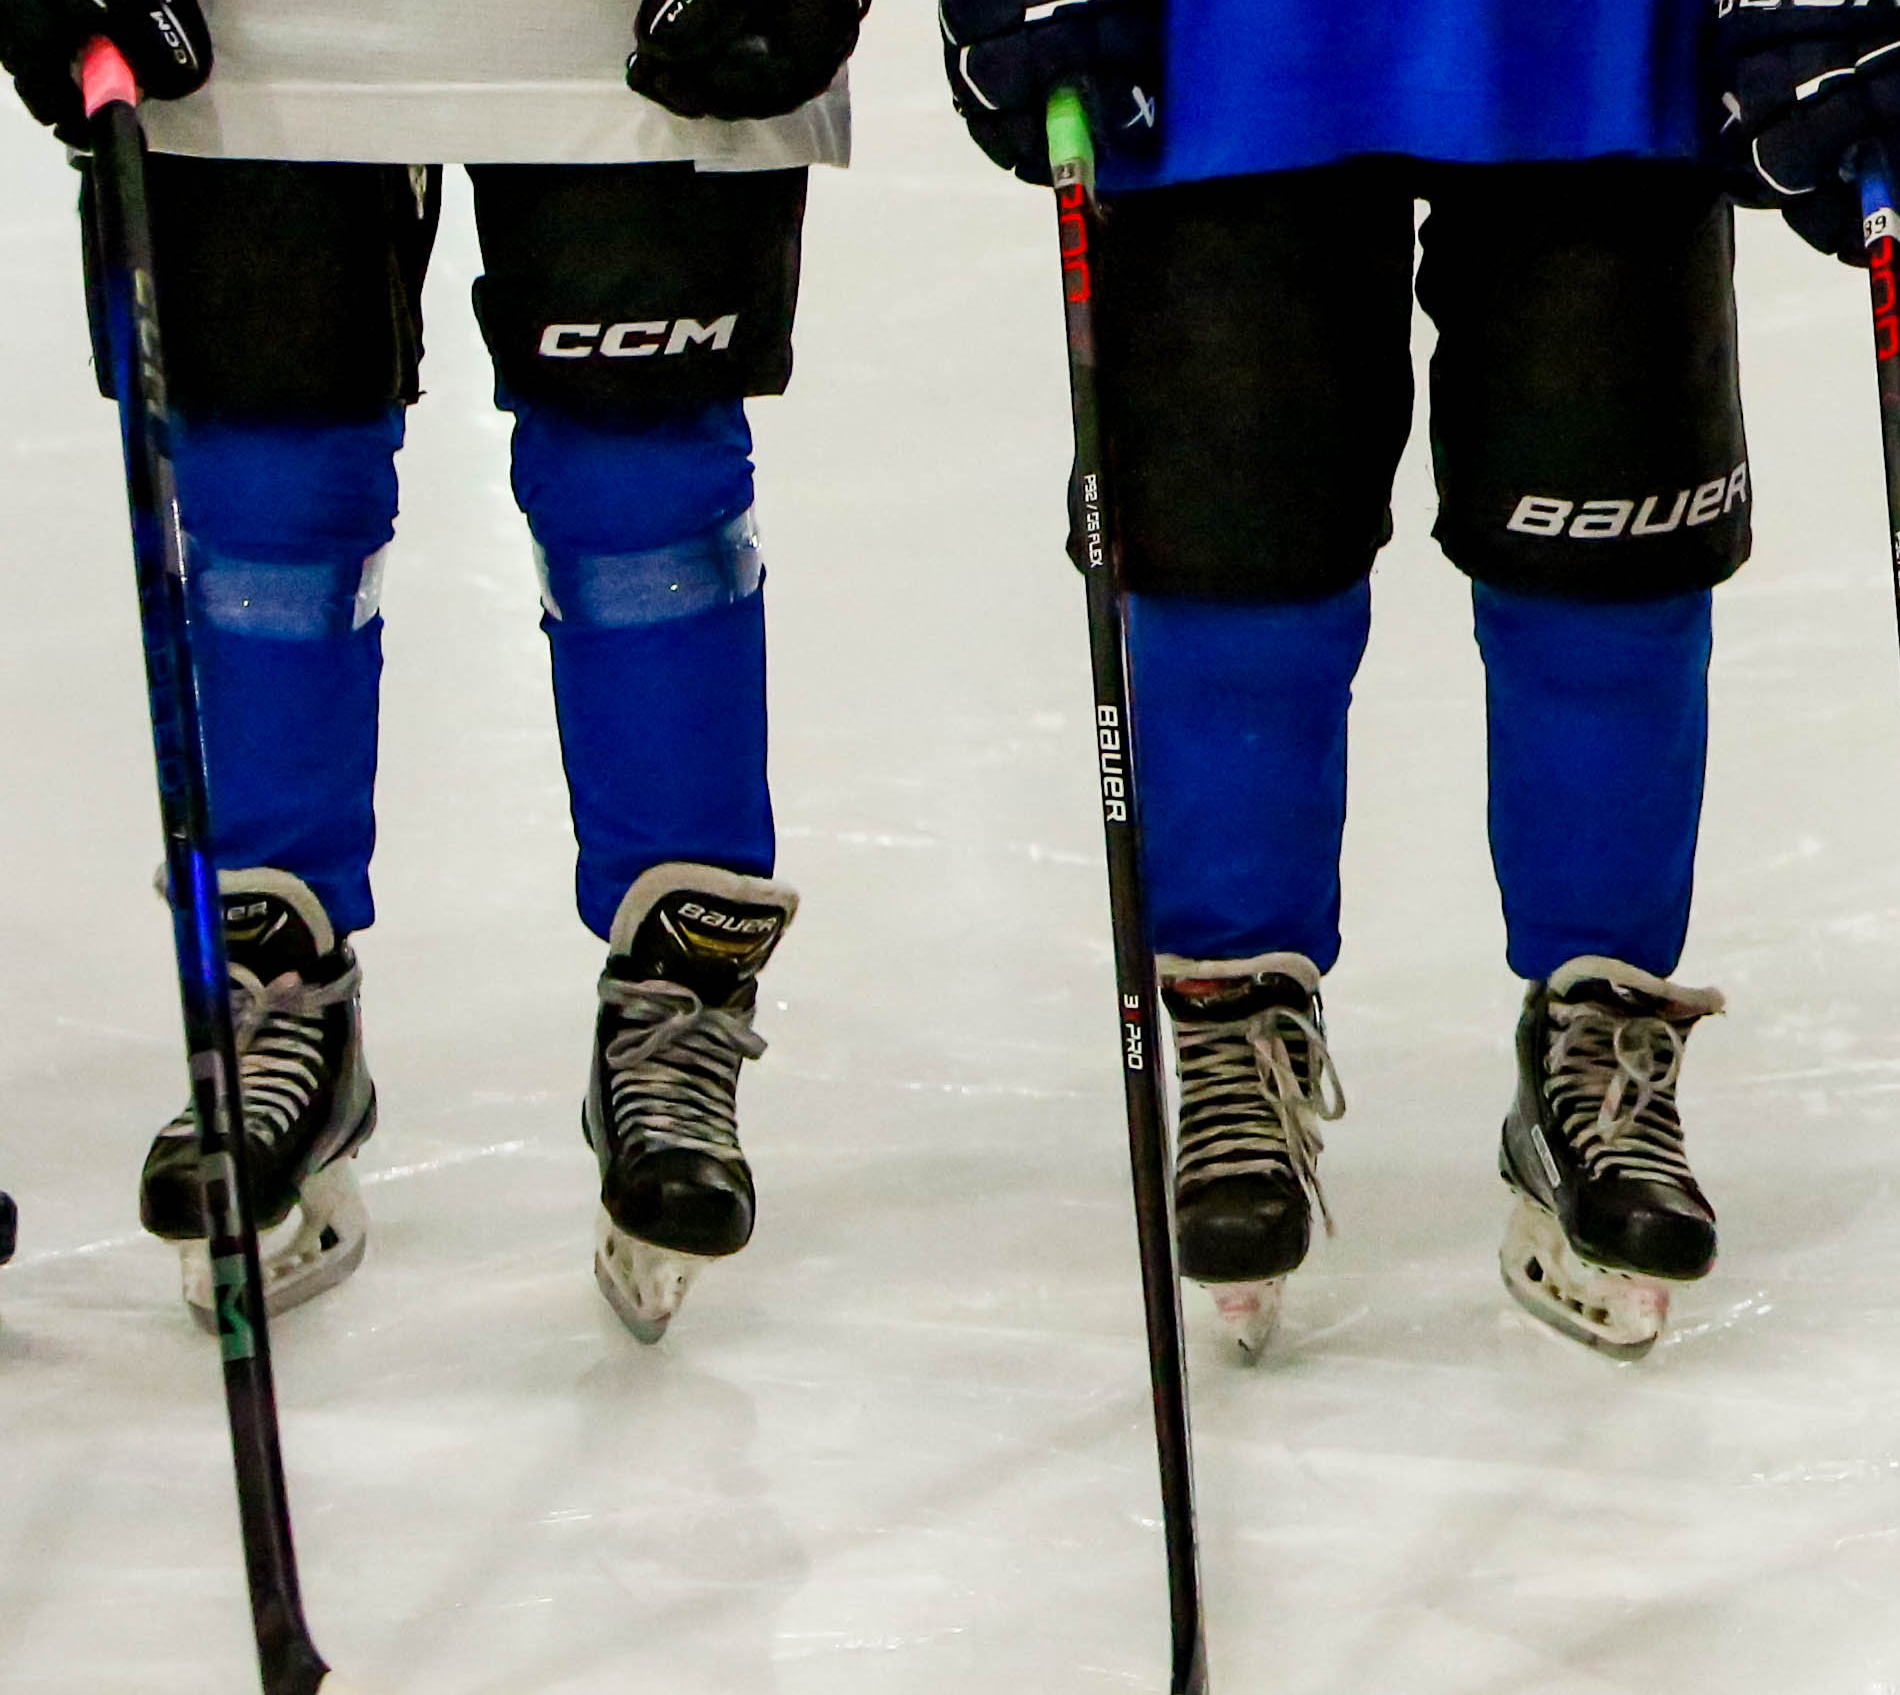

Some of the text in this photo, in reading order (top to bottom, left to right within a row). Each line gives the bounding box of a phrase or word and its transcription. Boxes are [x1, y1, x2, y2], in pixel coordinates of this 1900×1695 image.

[538, 313, 738, 358] CCM
[1506, 461, 1747, 539] BAUER
[1088, 532, 1104, 568] FLEX
[1097, 704, 1127, 823] BAUER
[1124, 1022, 1144, 1071] PRO
